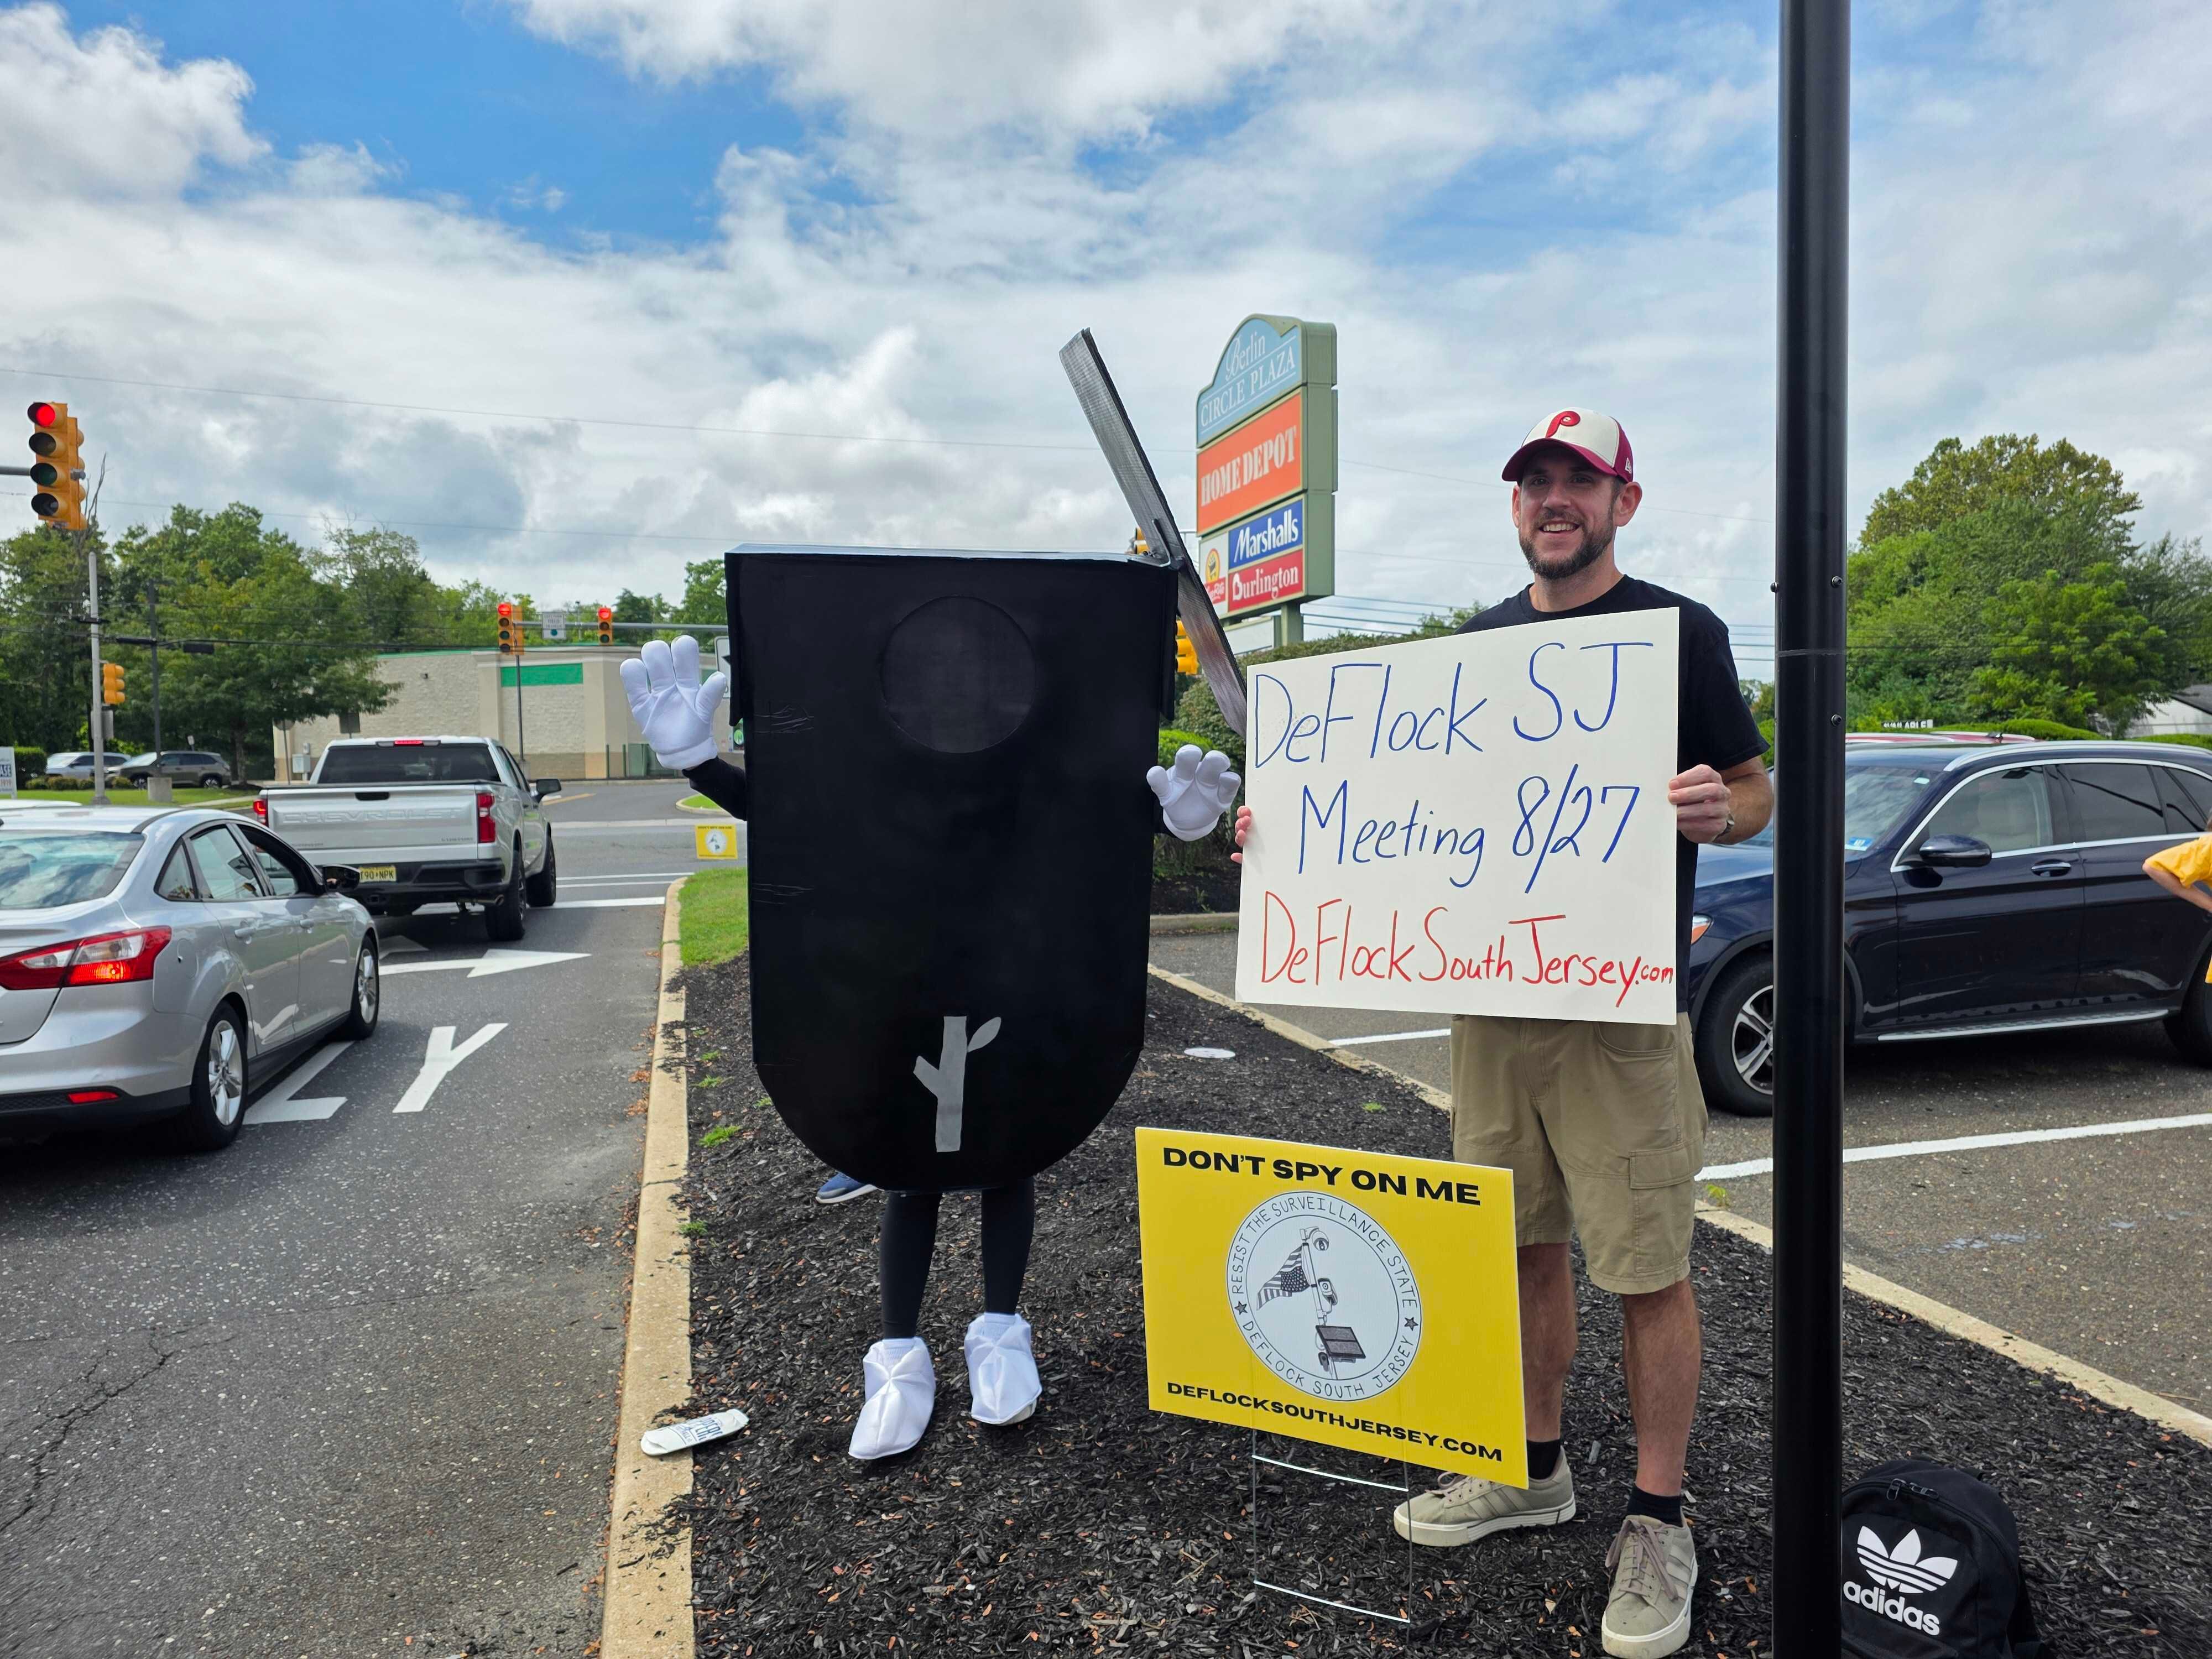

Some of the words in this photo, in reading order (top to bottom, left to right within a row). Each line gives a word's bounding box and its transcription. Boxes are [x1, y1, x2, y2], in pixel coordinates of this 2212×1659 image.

[1201, 379, 1245, 427] CIRCLE
[1250, 345, 1296, 396] PLAZA
[1225, 330, 1266, 382] Berlin
[1545, 410, 1580, 438] P
[1201, 455, 1240, 507] HOME
[1243, 426, 1297, 486] DEPOT
[1233, 509, 1298, 563] Marshalls
[1232, 566, 1299, 601] Burlington
[1254, 662, 1488, 768] DeFlock
[1512, 642, 1654, 742] SJ
[283, 808, 463, 823] CHEVROLET
[1298, 780, 1485, 888] Meeting
[1512, 763, 1640, 894] 8/27
[1261, 890, 1673, 1008] DeFlockSouthJersey.com
[1163, 1147, 1265, 1176] DON'T
[1272, 1159, 1343, 1186] SPY
[1350, 1170, 1407, 1195] ON
[1416, 1177, 1481, 1206] ME
[1231, 1233, 1251, 1295] RESIST
[1245, 1209, 1271, 1233] THE
[1271, 1196, 1390, 1254] SURVEILLANCE
[1387, 1255, 1418, 1309] STATE
[1243, 1321, 1305, 1387] DEFLOCK
[1312, 1380, 1365, 1399] SOUTH
[1372, 1335, 1414, 1388] JERSEY
[1166, 1382, 1503, 1462] DEFLOCKSOUTHJERSEY.COM
[1843, 1580, 1940, 1636] adidas
